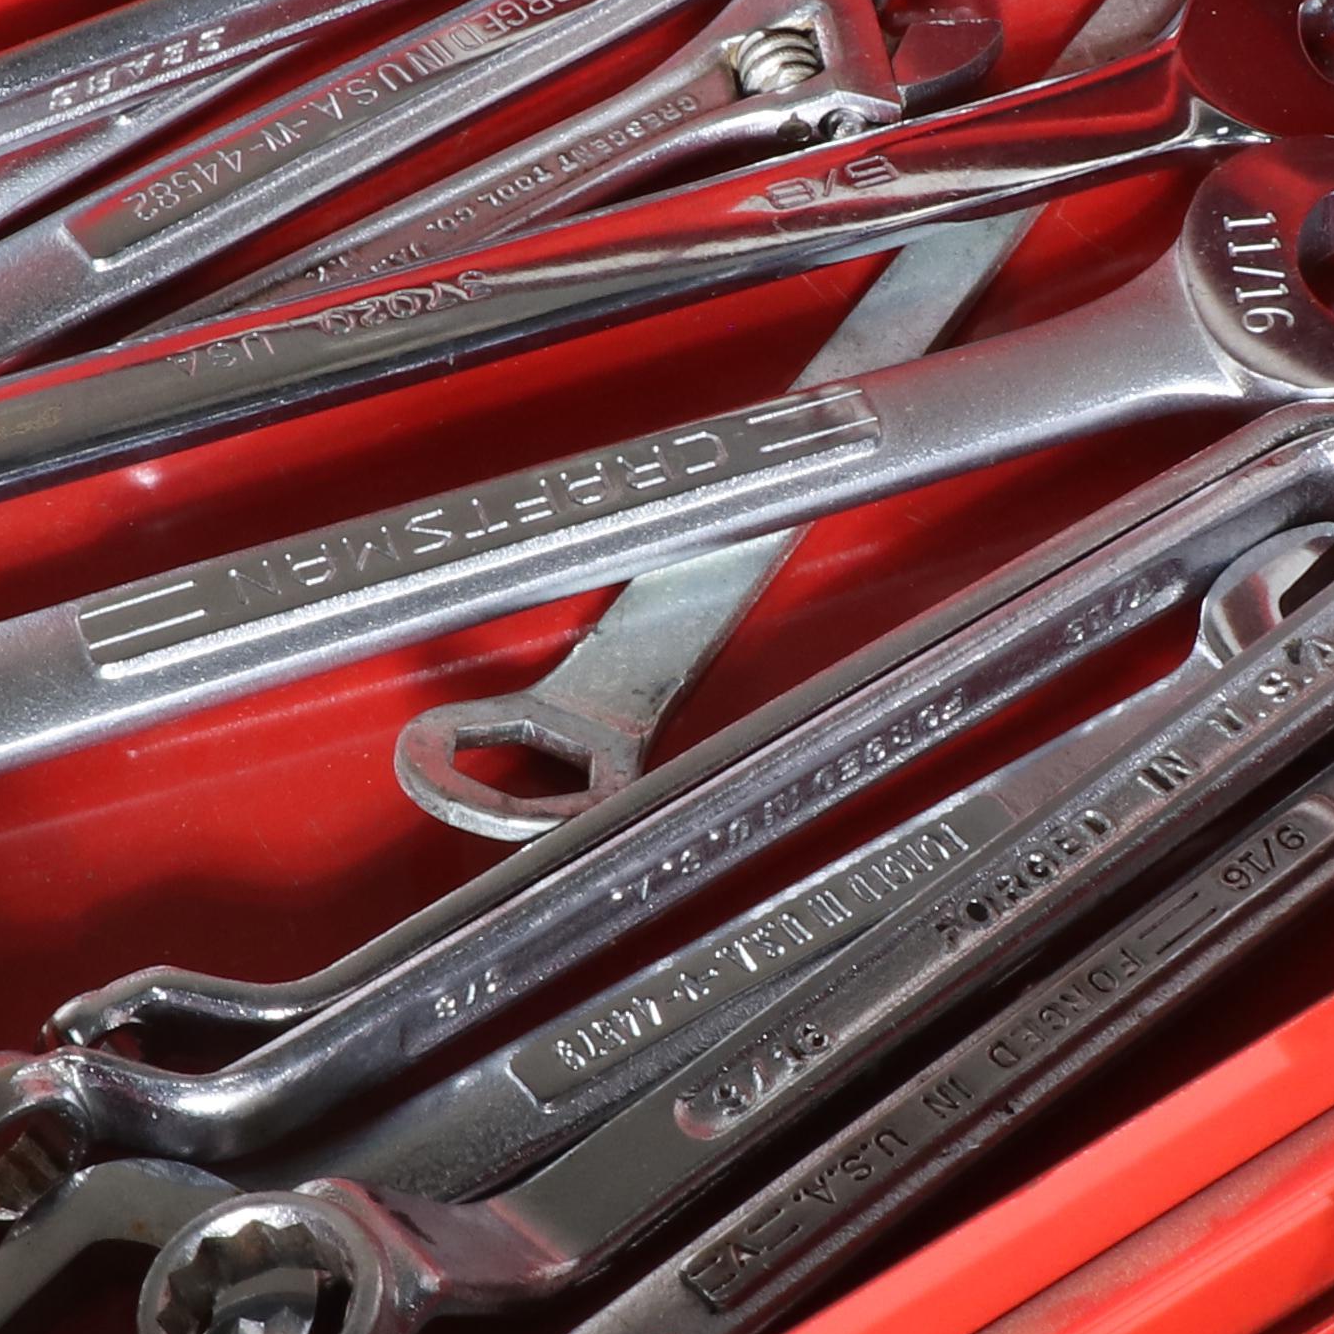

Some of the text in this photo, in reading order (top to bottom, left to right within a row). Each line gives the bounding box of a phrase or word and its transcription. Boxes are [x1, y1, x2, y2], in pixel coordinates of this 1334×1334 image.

[50, 25, 227, 110] SEARS
[414, 39, 454, 75] IN
[557, 94, 699, 173] CRESCENT
[477, 164, 555, 209] TOOL
[765, 153, 900, 211] 5/8
[1221, 210, 1295, 335] 11/16
[168, 331, 278, 379] USA
[227, 428, 732, 608] CRAFTSMAN
[814, 687, 967, 793] FORGED
[761, 783, 802, 827] IN
[849, 821, 970, 904] FORGED
[933, 806, 1122, 949] FORGED
[1137, 748, 1201, 803] IN
[1220, 820, 1308, 893] 9/16
[807, 890, 853, 929] IN
[988, 944, 1149, 1071] FORGED
[921, 1074, 975, 1121] IN
[790, 1127, 912, 1211] U.S.A.
